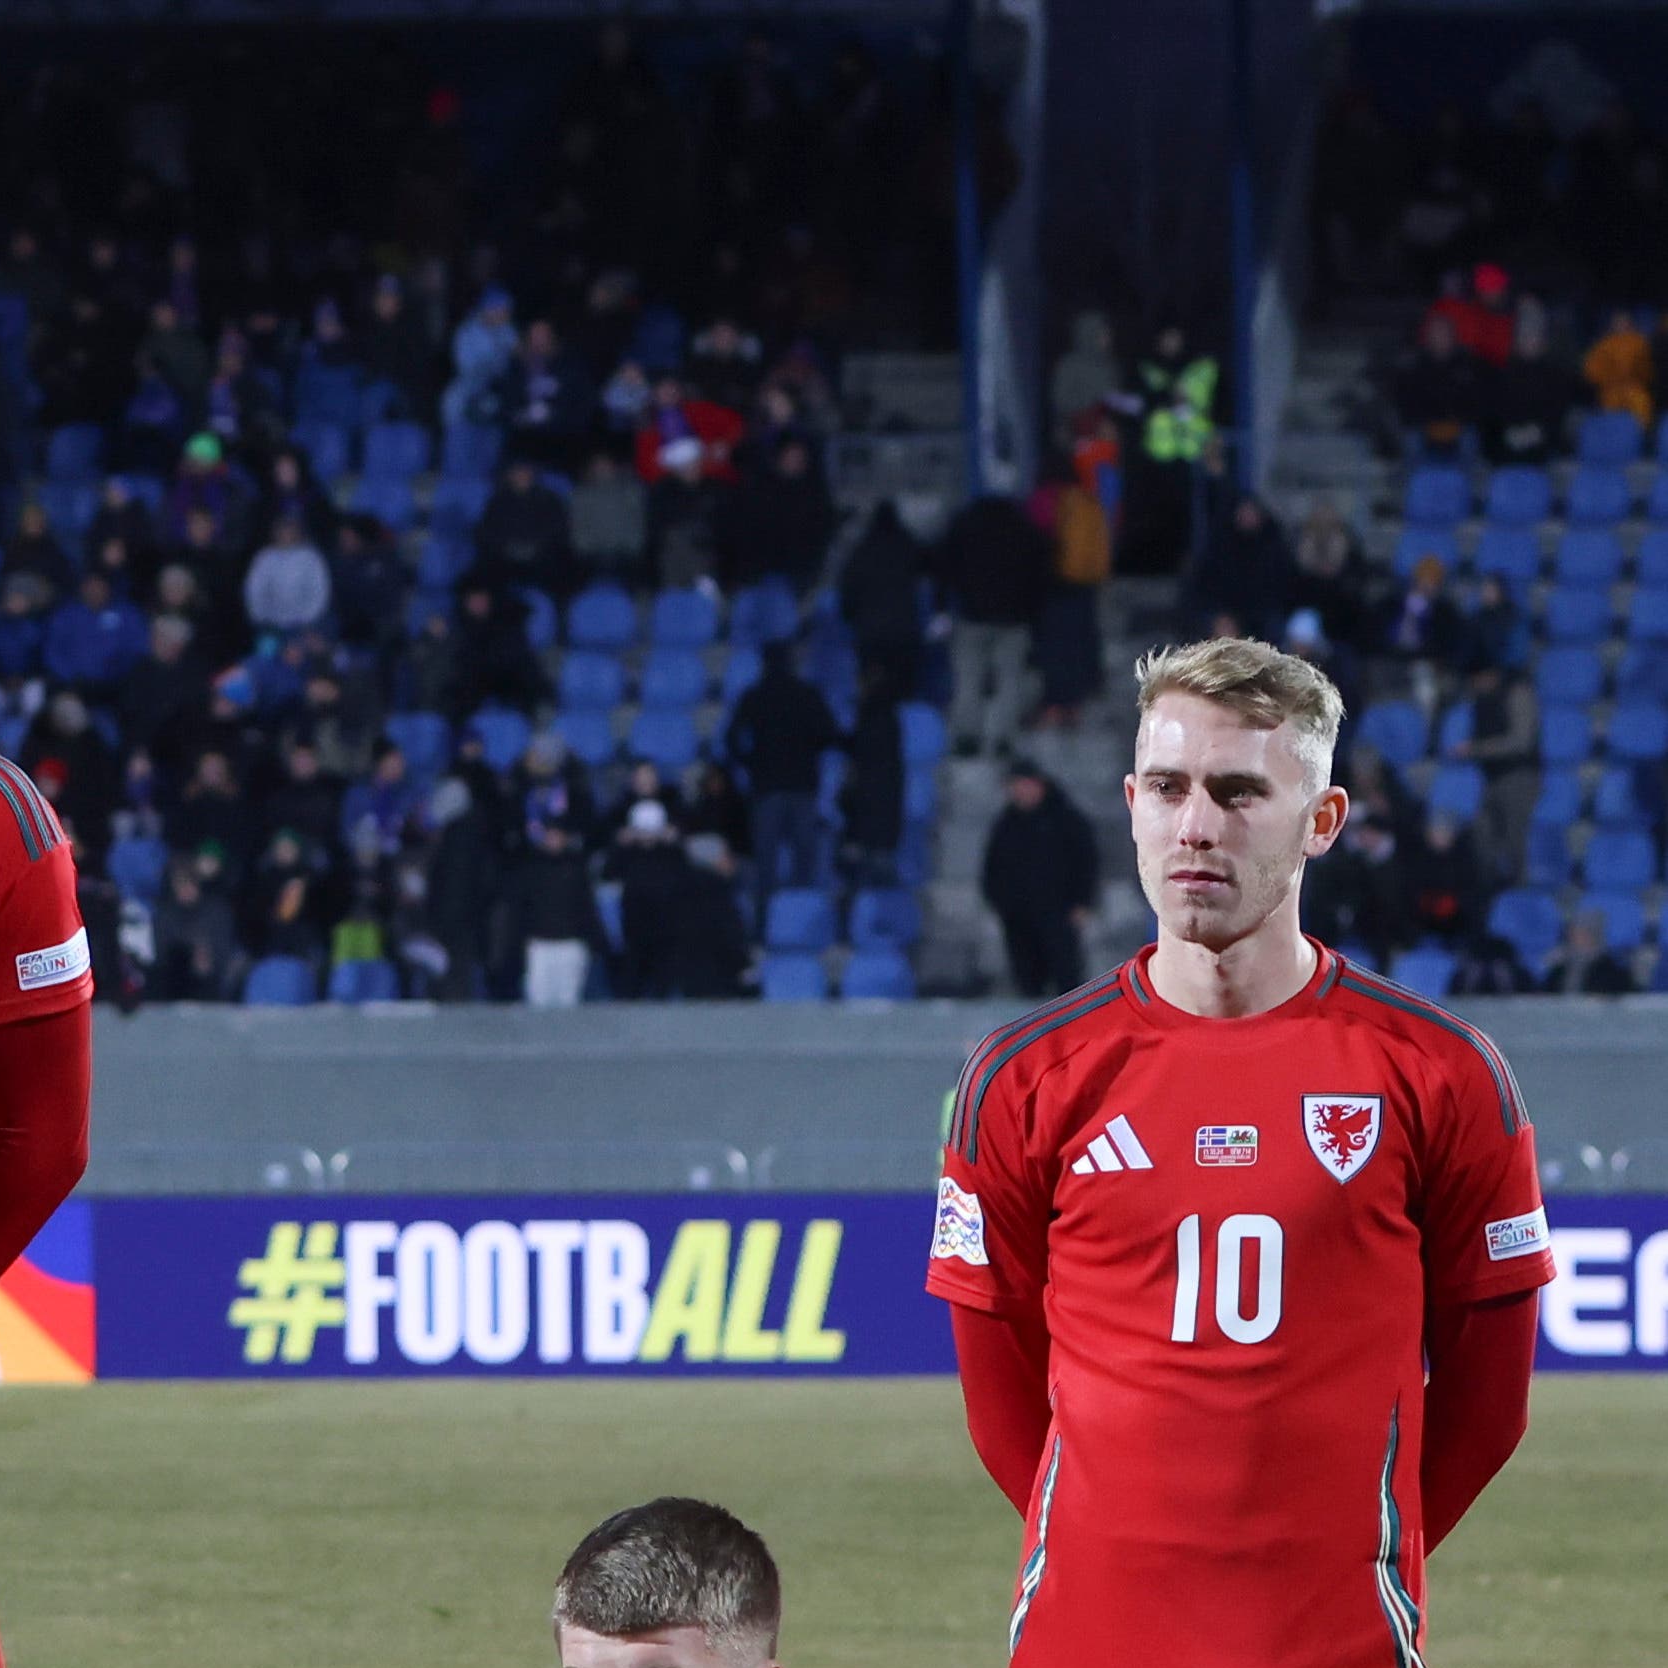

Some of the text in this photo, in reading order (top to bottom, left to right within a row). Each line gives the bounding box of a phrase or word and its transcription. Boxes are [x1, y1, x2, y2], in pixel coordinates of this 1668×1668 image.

[227, 1220, 846, 1365] #FOOTBALL
[1171, 1213, 1284, 1345] 10
[1488, 1222, 1513, 1234] UEFA
